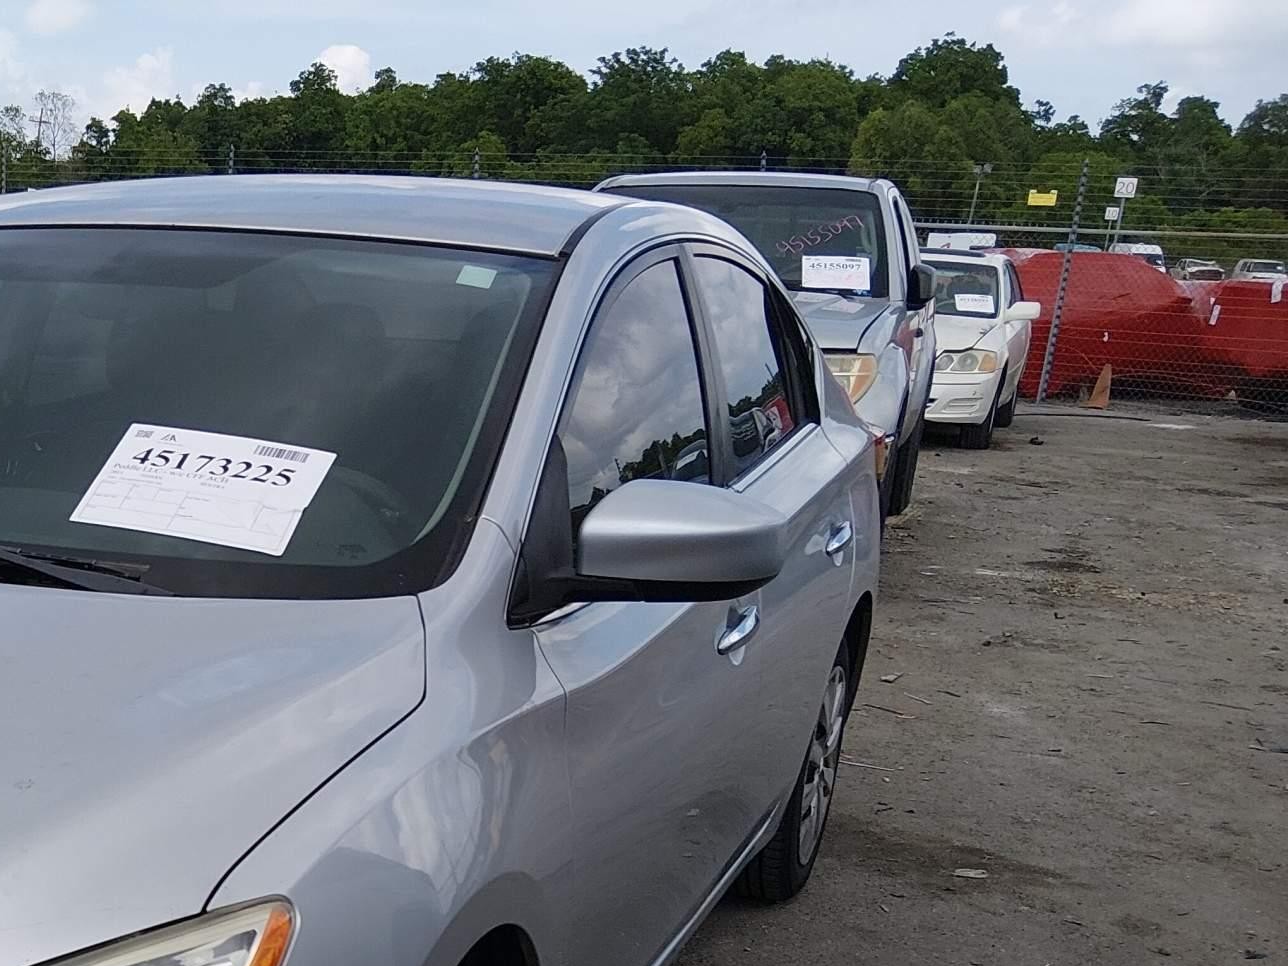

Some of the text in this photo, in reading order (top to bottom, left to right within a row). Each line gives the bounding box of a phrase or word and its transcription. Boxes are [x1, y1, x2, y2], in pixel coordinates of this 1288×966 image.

[1117, 181, 1135, 194] 20
[1106, 209, 1118, 218] 10
[808, 262, 861, 271] 45155097
[132, 447, 296, 487] 45173225
